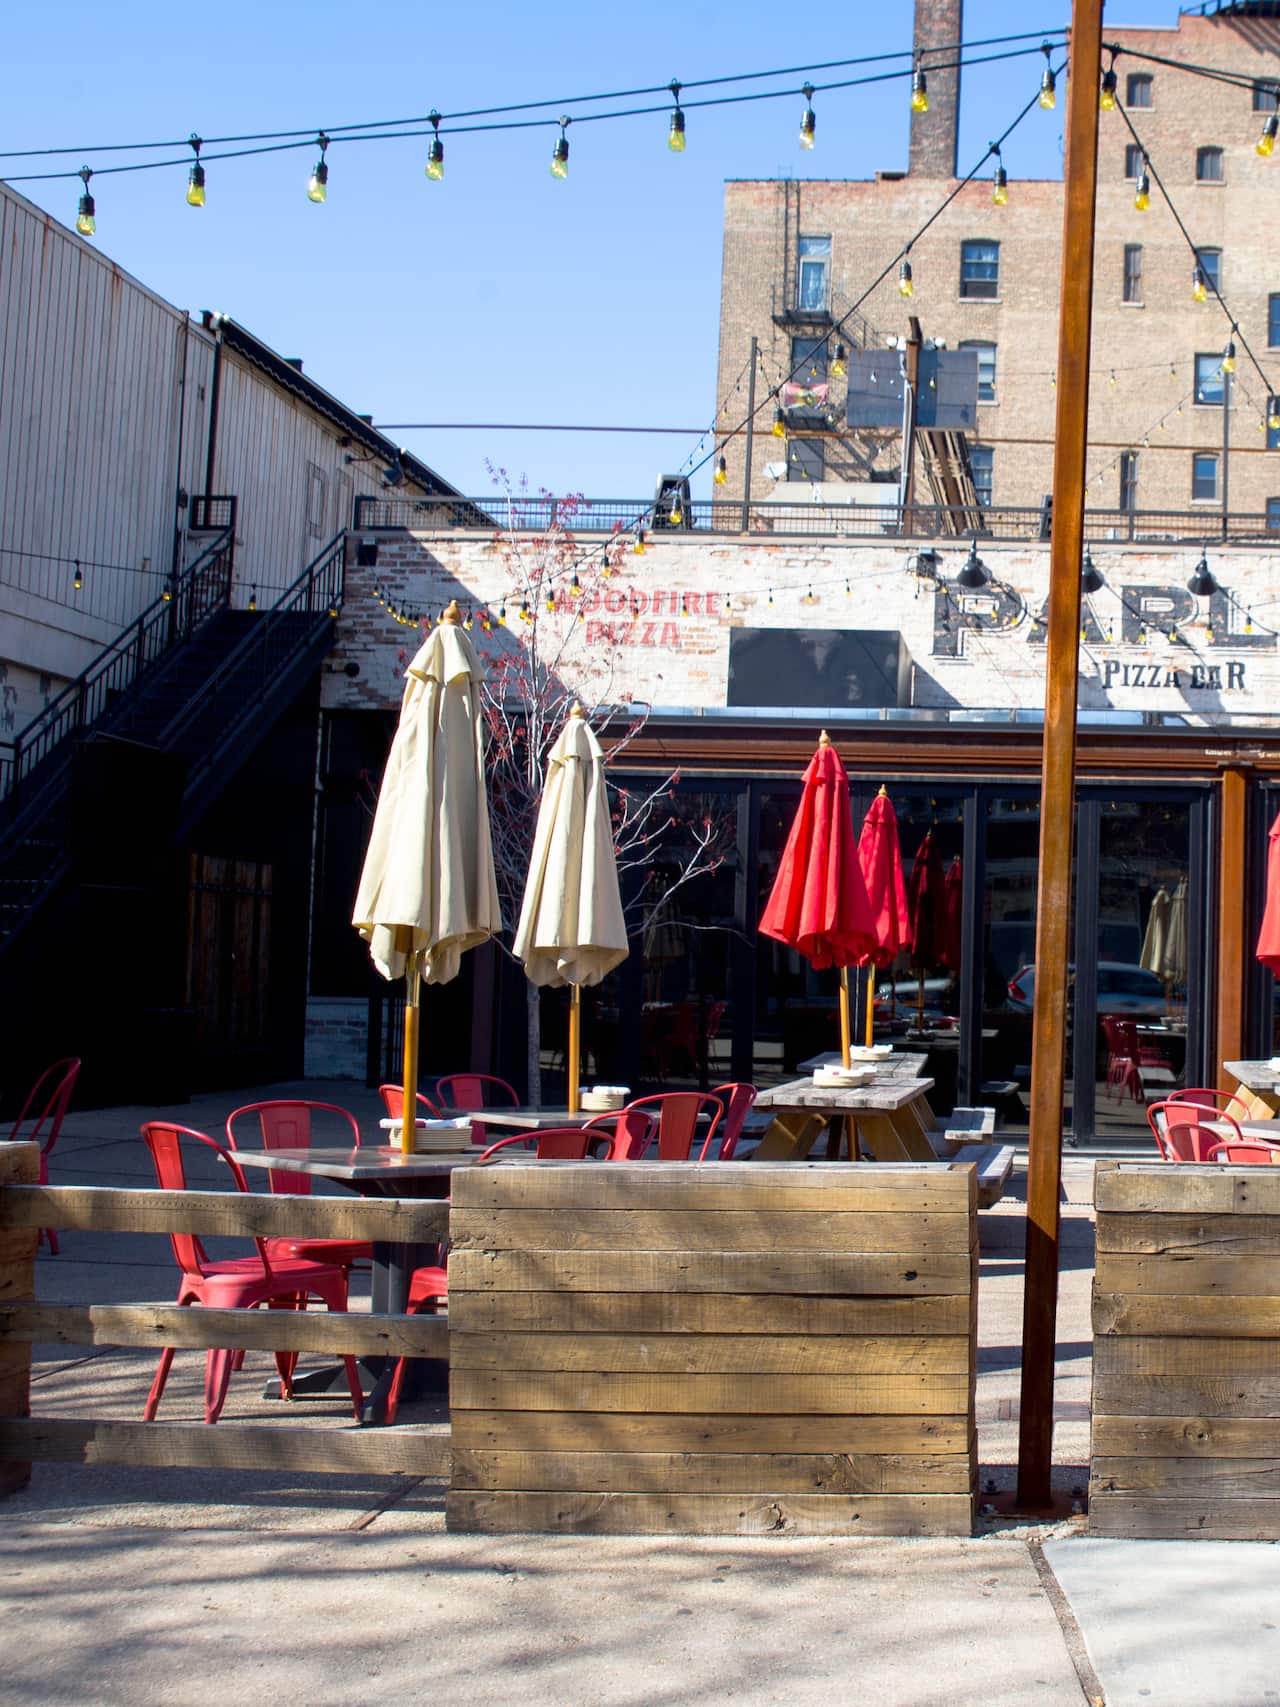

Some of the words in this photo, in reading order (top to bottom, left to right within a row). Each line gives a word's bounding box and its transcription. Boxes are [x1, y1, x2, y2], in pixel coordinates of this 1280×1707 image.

[586, 620, 681, 648] PIZZA
[1102, 659, 1181, 690] PIZZA
[1190, 661, 1247, 690] BAR
